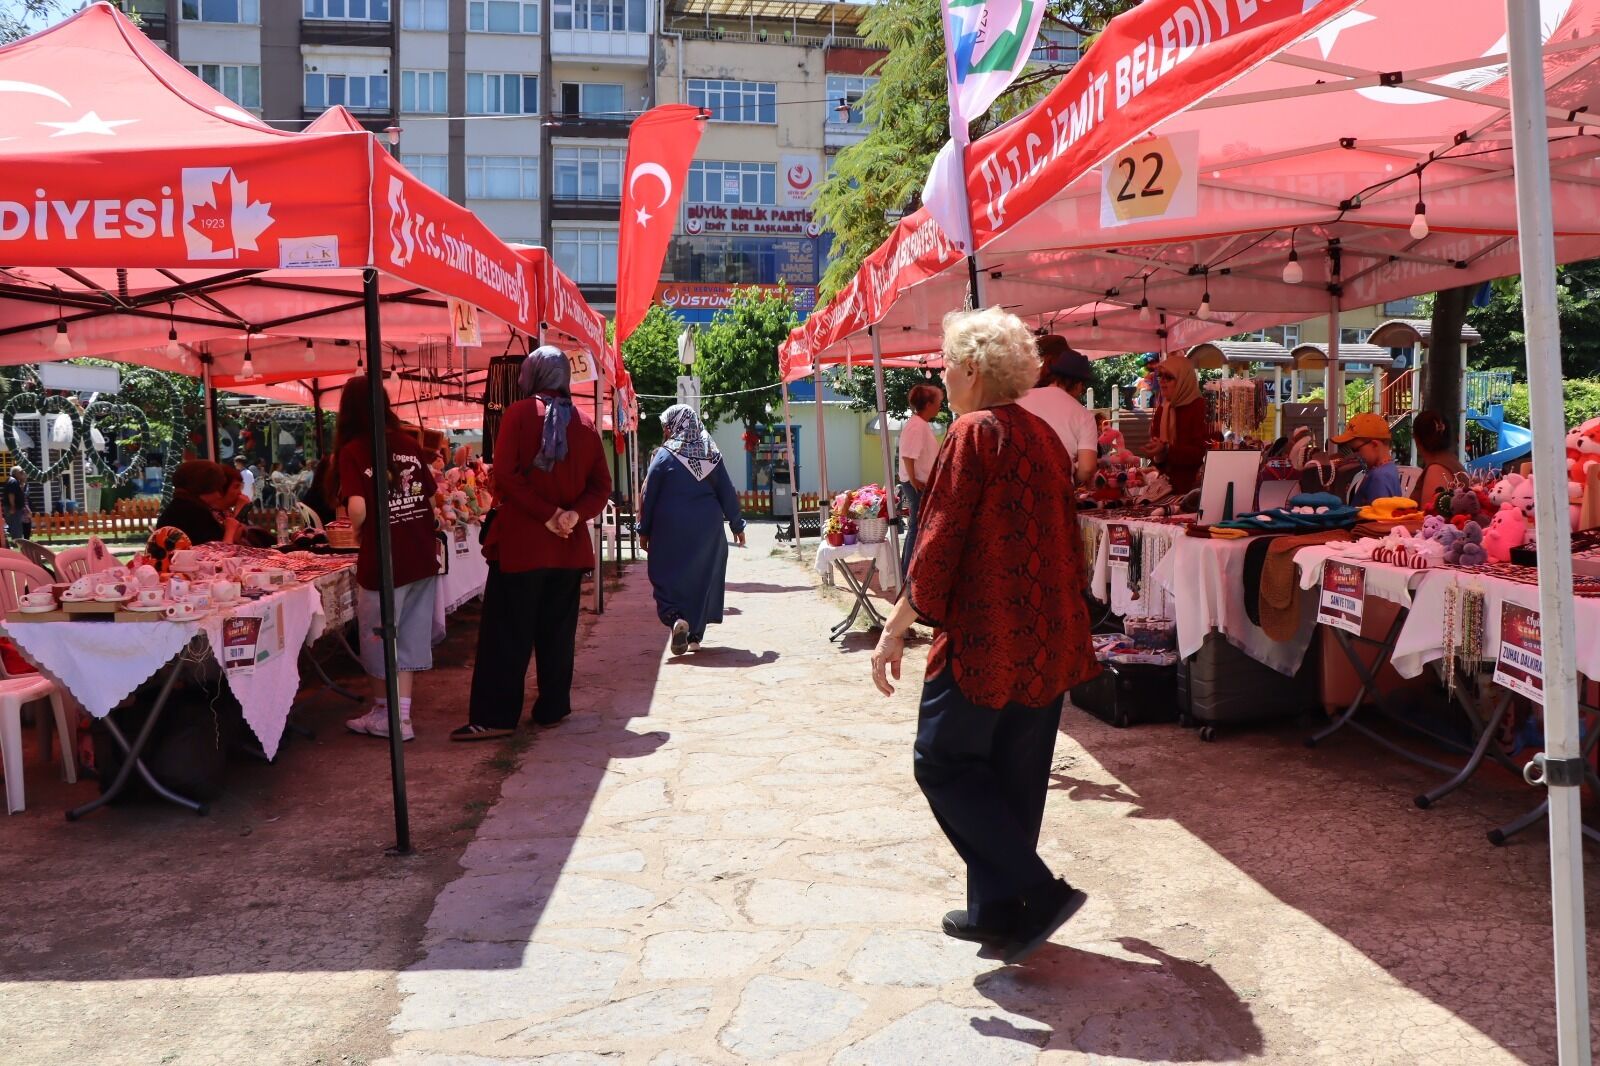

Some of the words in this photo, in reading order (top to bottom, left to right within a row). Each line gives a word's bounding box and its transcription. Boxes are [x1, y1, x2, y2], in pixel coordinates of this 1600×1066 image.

[1007, 132, 1048, 188] T.C.
[1047, 71, 1109, 161] İZMİT
[1116, 151, 1164, 202] 22
[688, 205, 727, 219] BÜYÜK
[731, 206, 767, 221] BİRLİK
[201, 218, 225, 229] 1923
[442, 222, 473, 276] İZMİT
[569, 355, 588, 374] 15
[1503, 646, 1519, 664] ZUHAL
